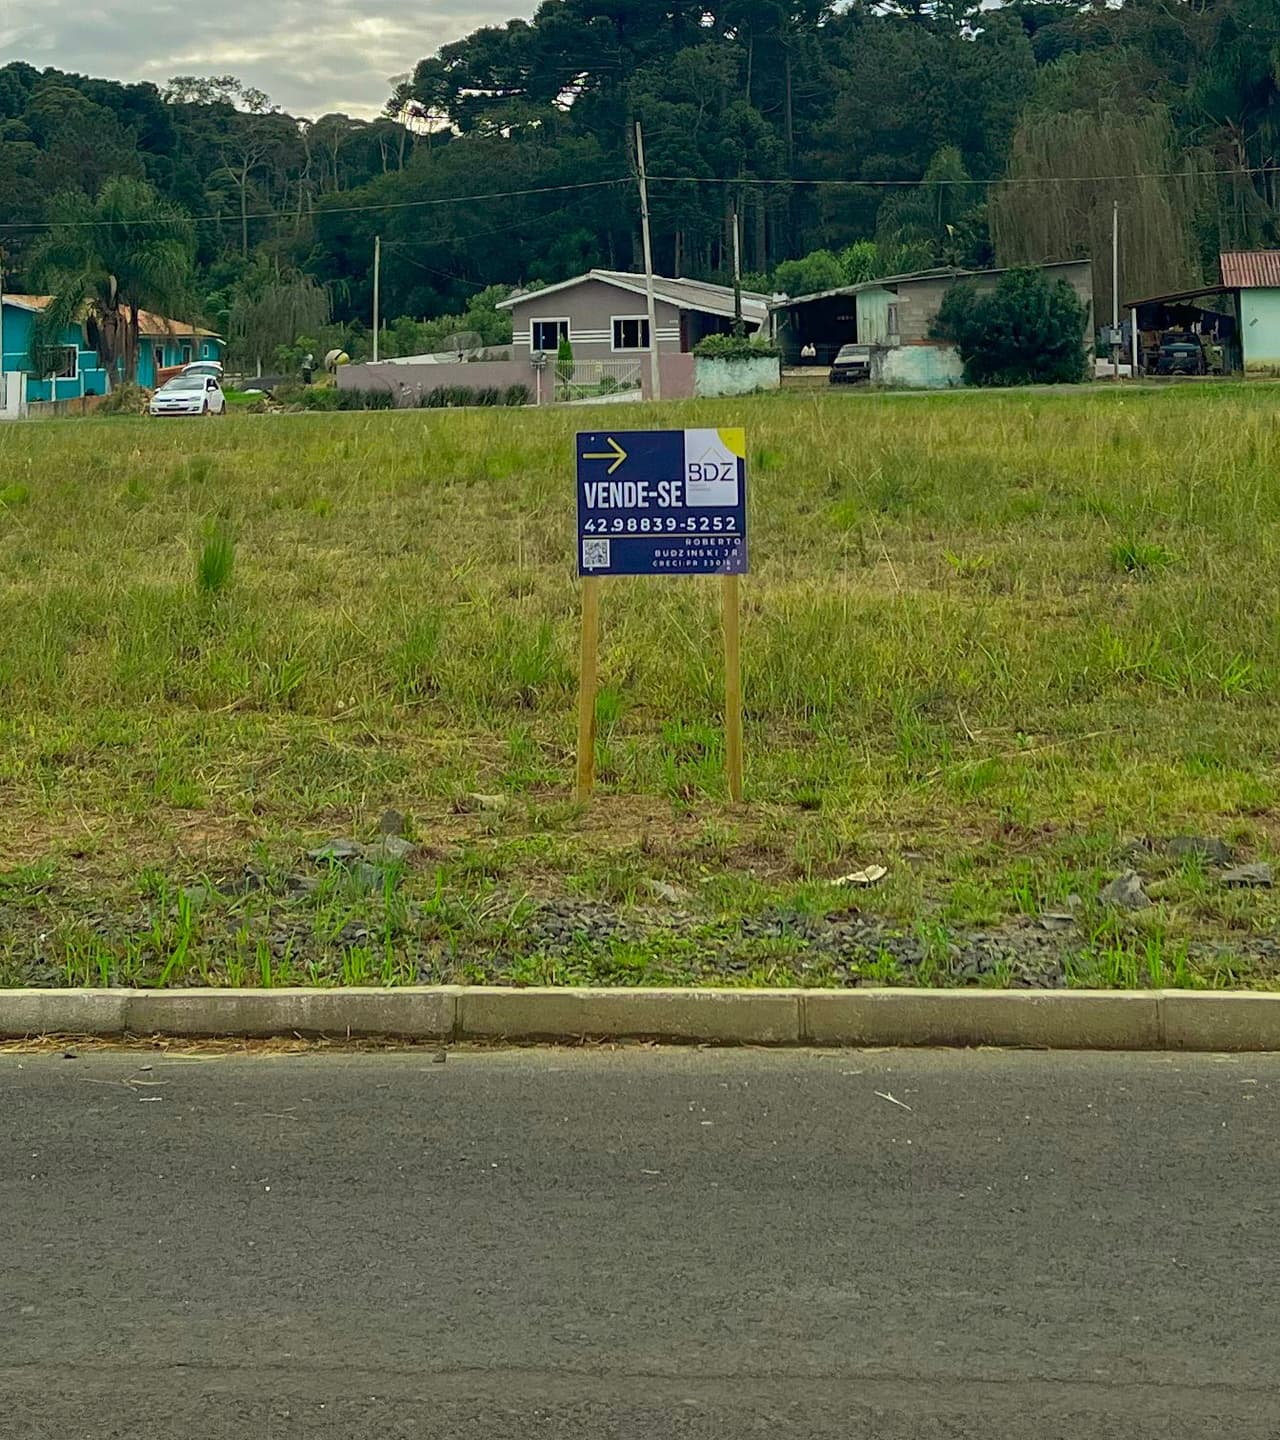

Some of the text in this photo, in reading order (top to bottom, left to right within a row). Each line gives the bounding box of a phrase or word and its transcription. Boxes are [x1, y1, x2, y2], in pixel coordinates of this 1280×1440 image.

[688, 462, 735, 482] BDZ
[584, 481, 683, 509] VENDE-SE
[584, 517, 737, 533] 42.98839-5252
[685, 538, 741, 546] ROBERTO
[654, 549, 719, 558] BUDZINSKI
